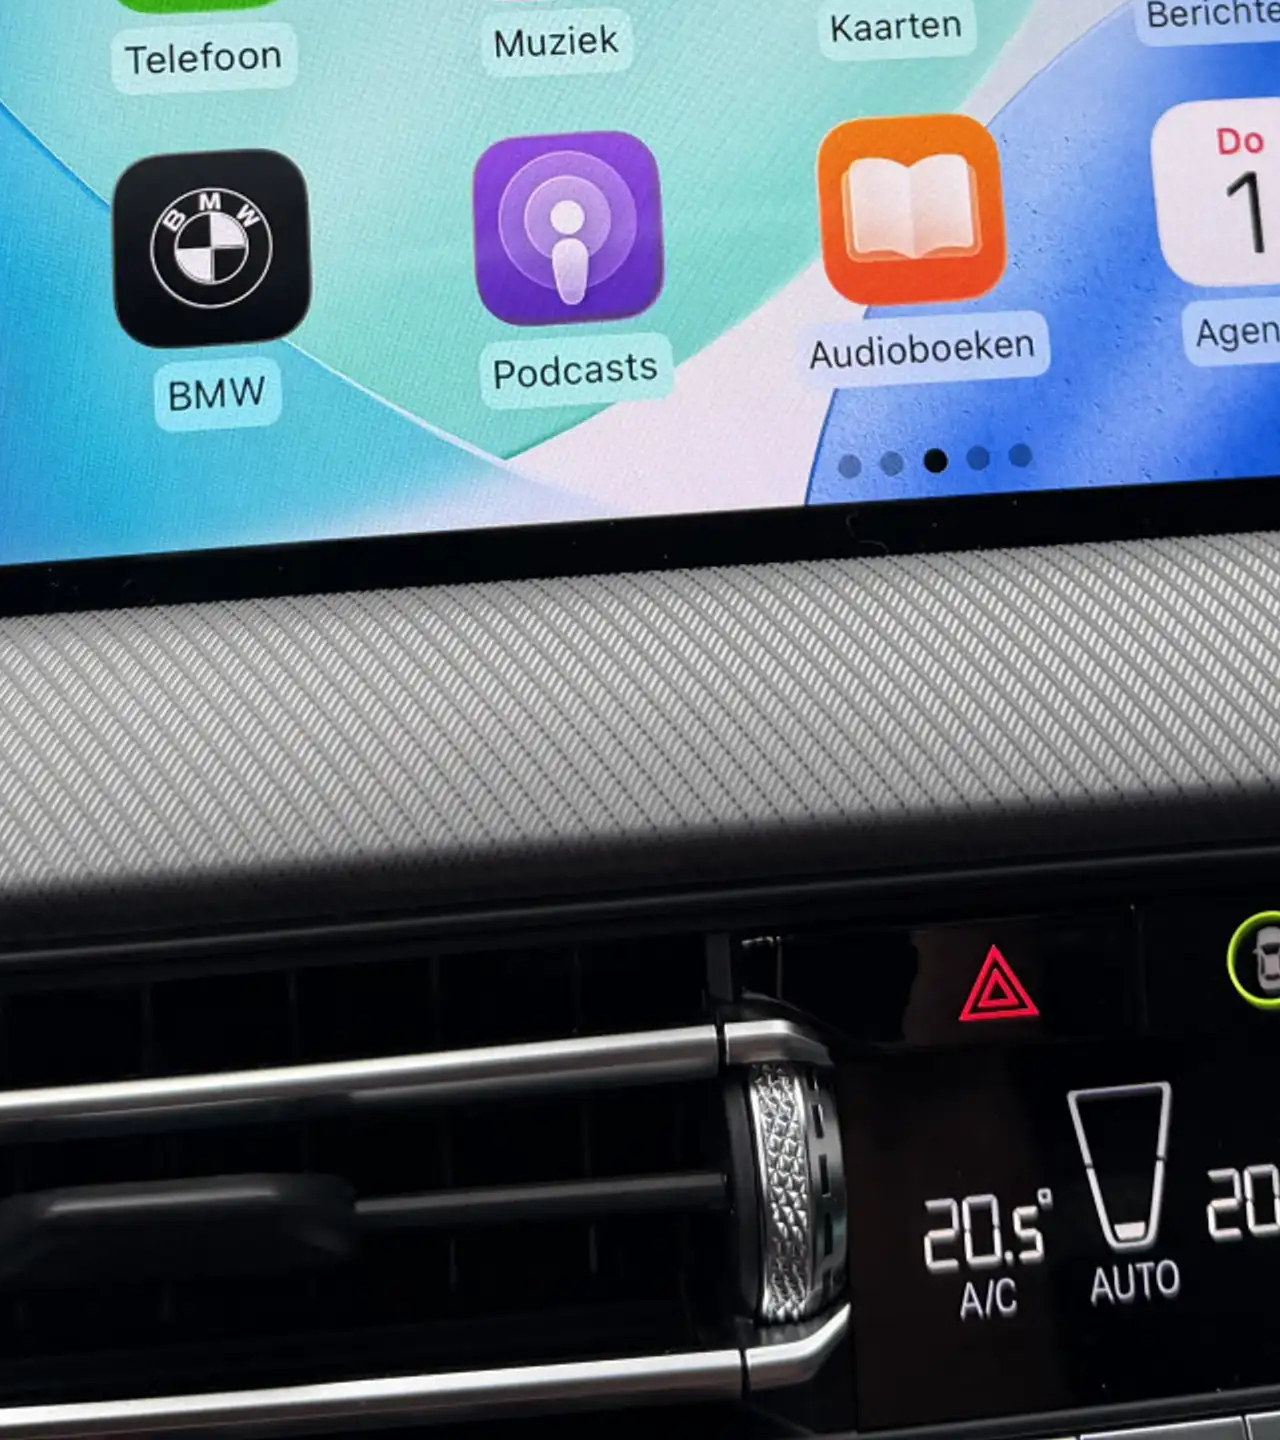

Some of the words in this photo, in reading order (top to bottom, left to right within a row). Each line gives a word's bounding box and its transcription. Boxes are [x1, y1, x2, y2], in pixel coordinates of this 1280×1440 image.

[495, 25, 619, 59] Muziek
[831, 11, 962, 43] Kaarten
[125, 42, 282, 75] Telefoon
[1217, 128, 1264, 155] Do
[163, 192, 260, 231] BMW
[1226, 171, 1265, 254] 1
[809, 330, 1035, 370] Audioboeken
[494, 353, 658, 389] Podcasts
[169, 376, 266, 411] BMW
[961, 1277, 1018, 1319] A/C
[1091, 1260, 1181, 1304] AUTO
